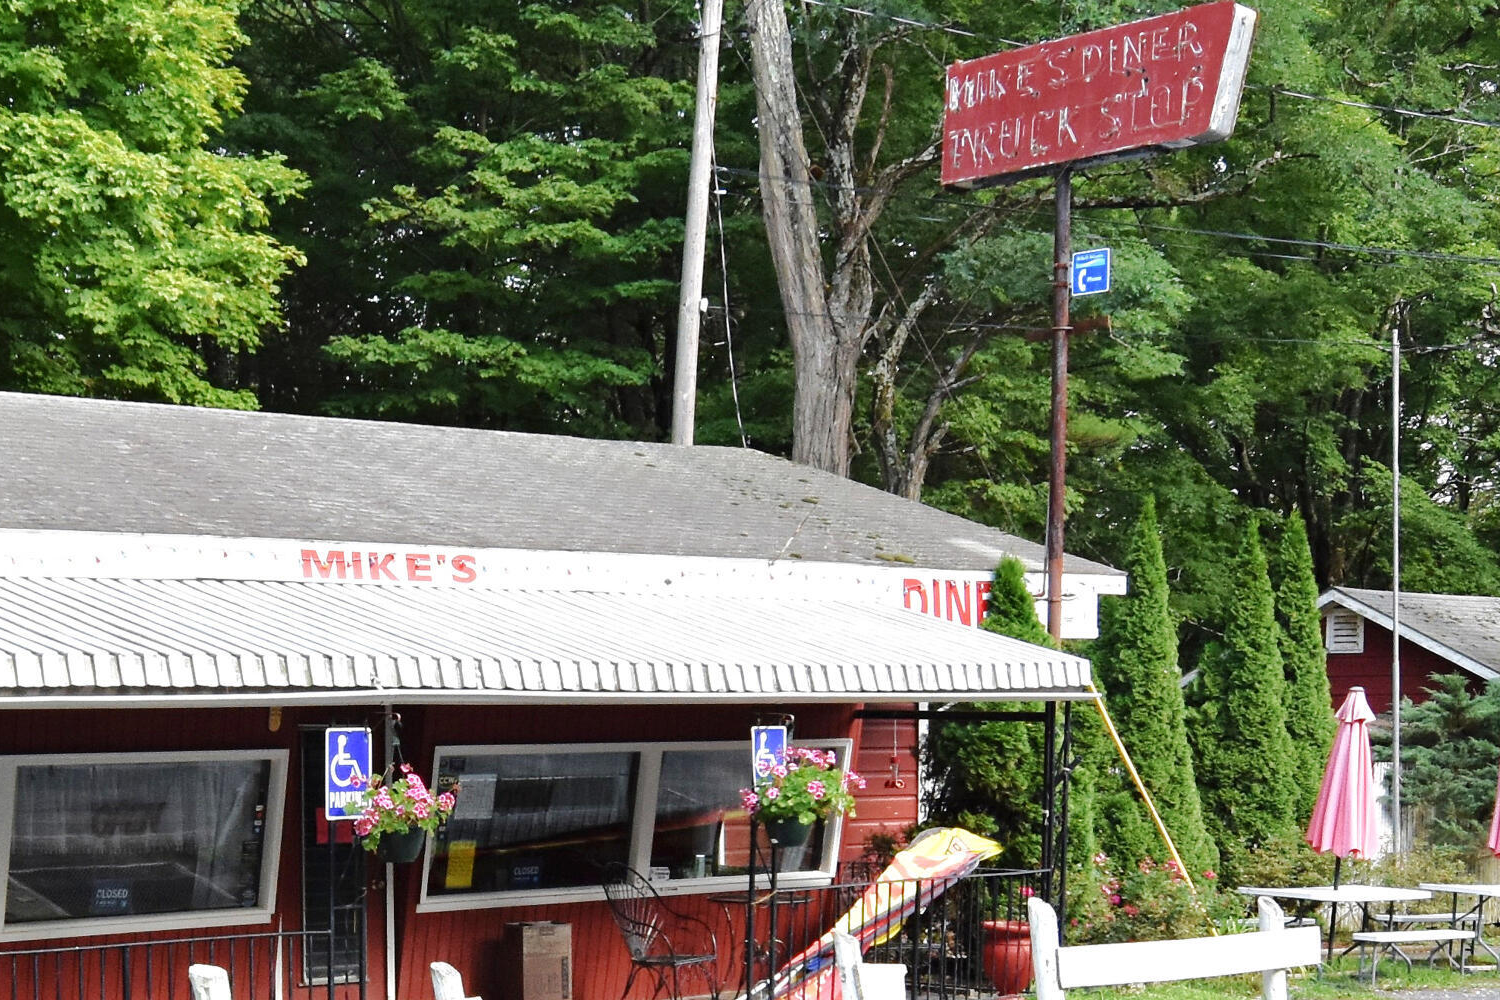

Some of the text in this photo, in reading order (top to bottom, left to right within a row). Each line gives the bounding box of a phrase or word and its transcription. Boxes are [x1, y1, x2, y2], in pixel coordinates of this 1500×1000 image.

[1082, 21, 1204, 82] DINER
[1099, 76, 1204, 144] STOP
[301, 549, 477, 583] MIKE'S
[903, 578, 991, 628] DINE
[513, 866, 539, 876] CLOSED
[96, 888, 128, 899] CLOSED
